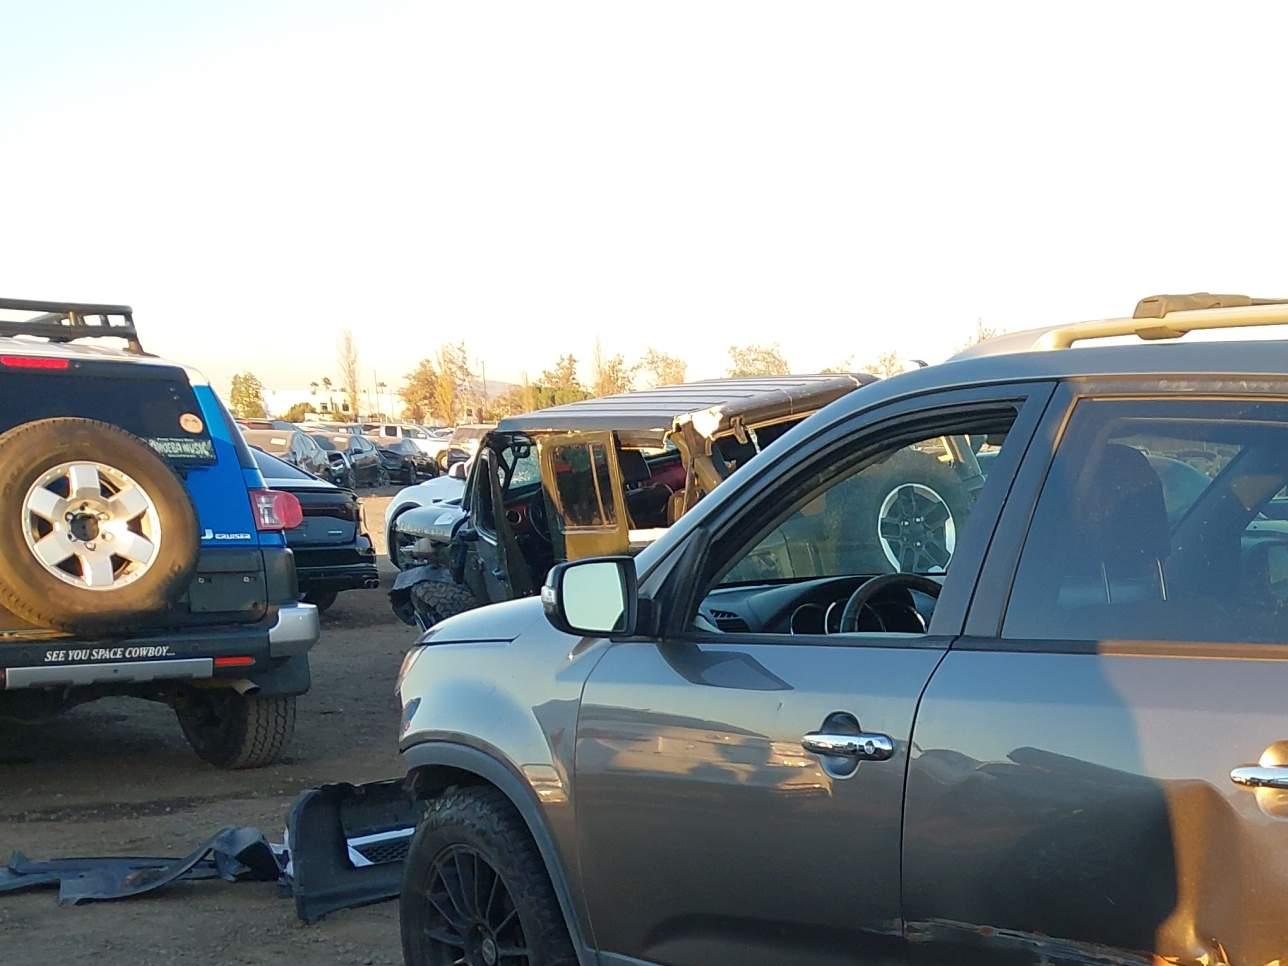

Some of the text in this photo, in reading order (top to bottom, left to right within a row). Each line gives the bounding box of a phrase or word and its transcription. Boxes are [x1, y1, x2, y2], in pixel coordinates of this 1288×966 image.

[44, 650, 65, 662] SEE
[68, 649, 89, 660] YOU
[91, 647, 124, 659] SPACE
